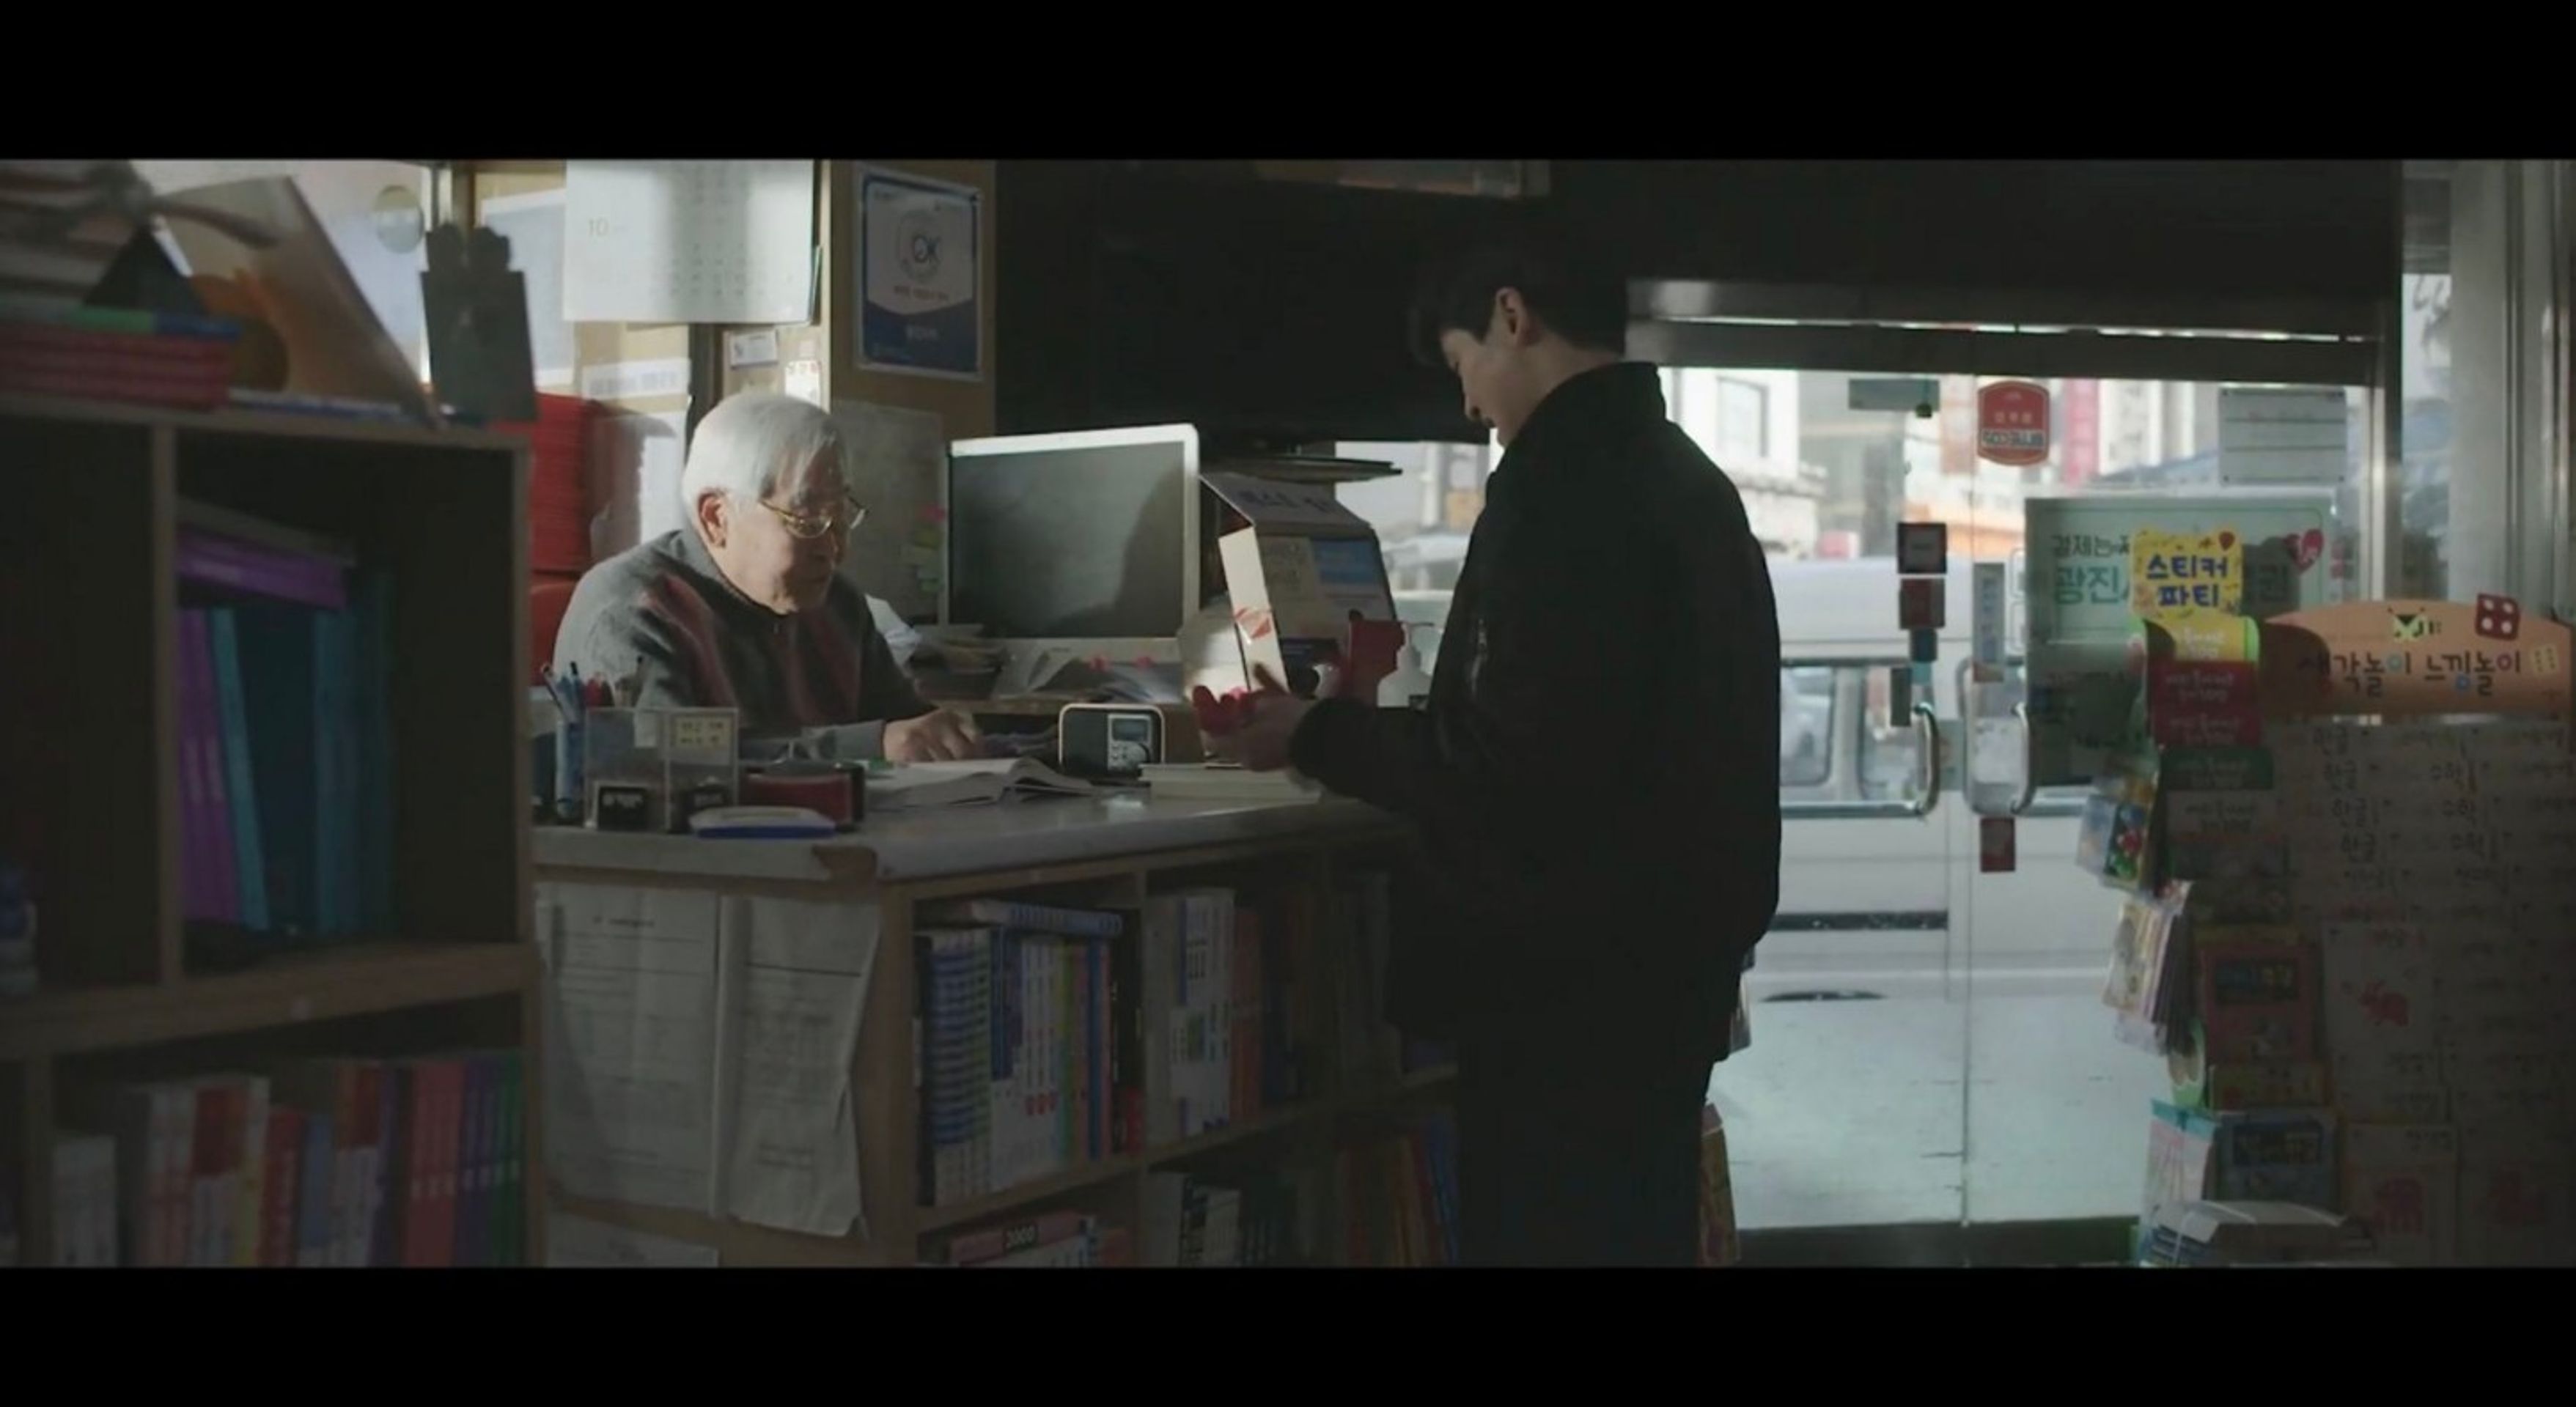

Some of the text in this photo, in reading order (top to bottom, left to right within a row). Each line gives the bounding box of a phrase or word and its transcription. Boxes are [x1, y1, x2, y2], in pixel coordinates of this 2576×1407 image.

[587, 217, 608, 237] 10
[2144, 554, 2229, 581] 스티커
[2156, 583, 2220, 608] 파티
[2424, 649, 2522, 698] 느낌놀이
